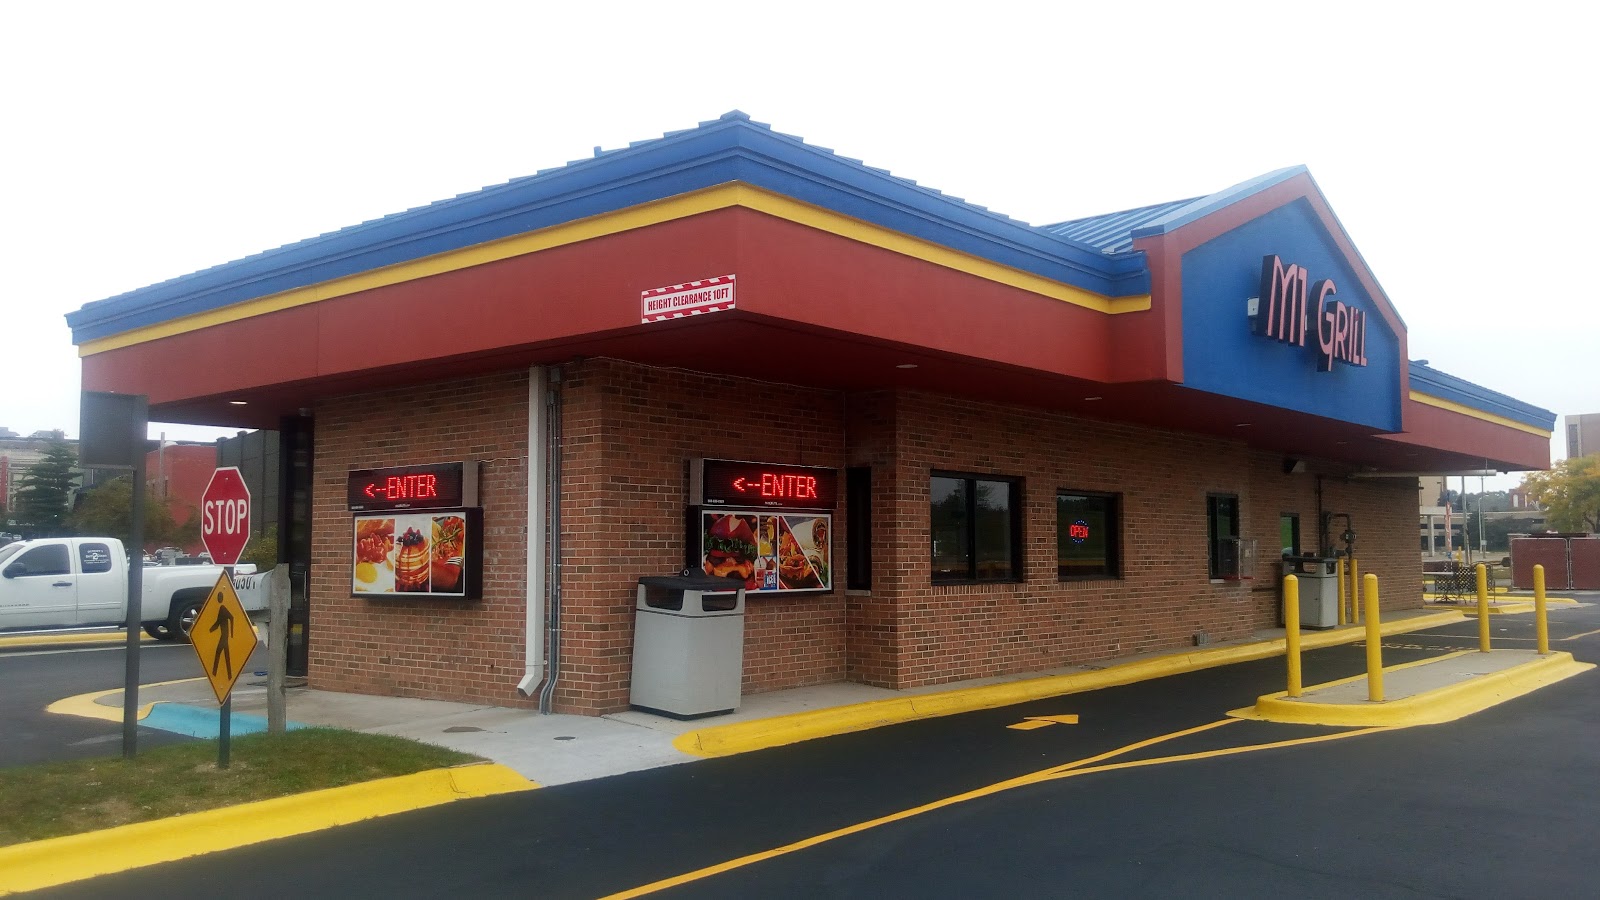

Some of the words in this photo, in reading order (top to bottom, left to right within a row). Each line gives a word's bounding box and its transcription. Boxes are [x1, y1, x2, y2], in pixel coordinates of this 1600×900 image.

[648, 297, 672, 312] HEIGHT
[673, 290, 712, 307] CLEARANCE
[1315, 279, 1368, 372] GRILL
[204, 499, 248, 535] STOP
[1070, 525, 1088, 538] OPEN
